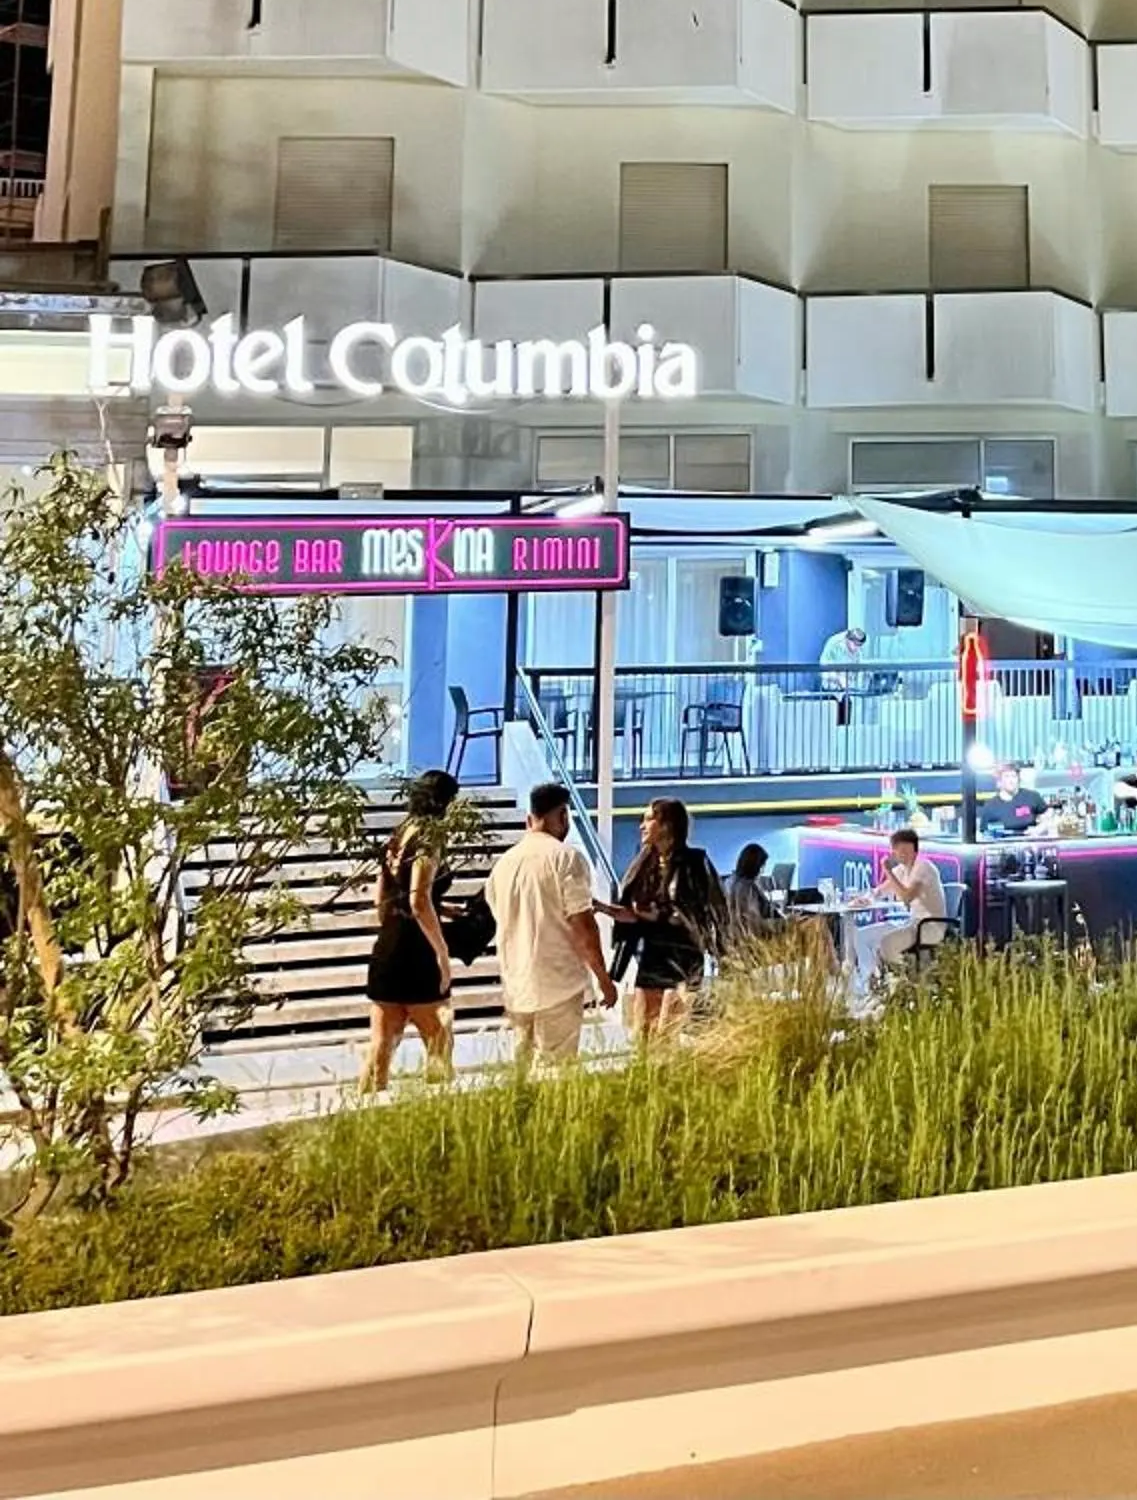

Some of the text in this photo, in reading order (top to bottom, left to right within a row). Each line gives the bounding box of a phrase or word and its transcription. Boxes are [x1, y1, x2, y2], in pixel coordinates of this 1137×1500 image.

[88, 311, 699, 404] Hotel Columbia
[293, 538, 344, 574] BAR
[512, 536, 601, 572] RIMINI
